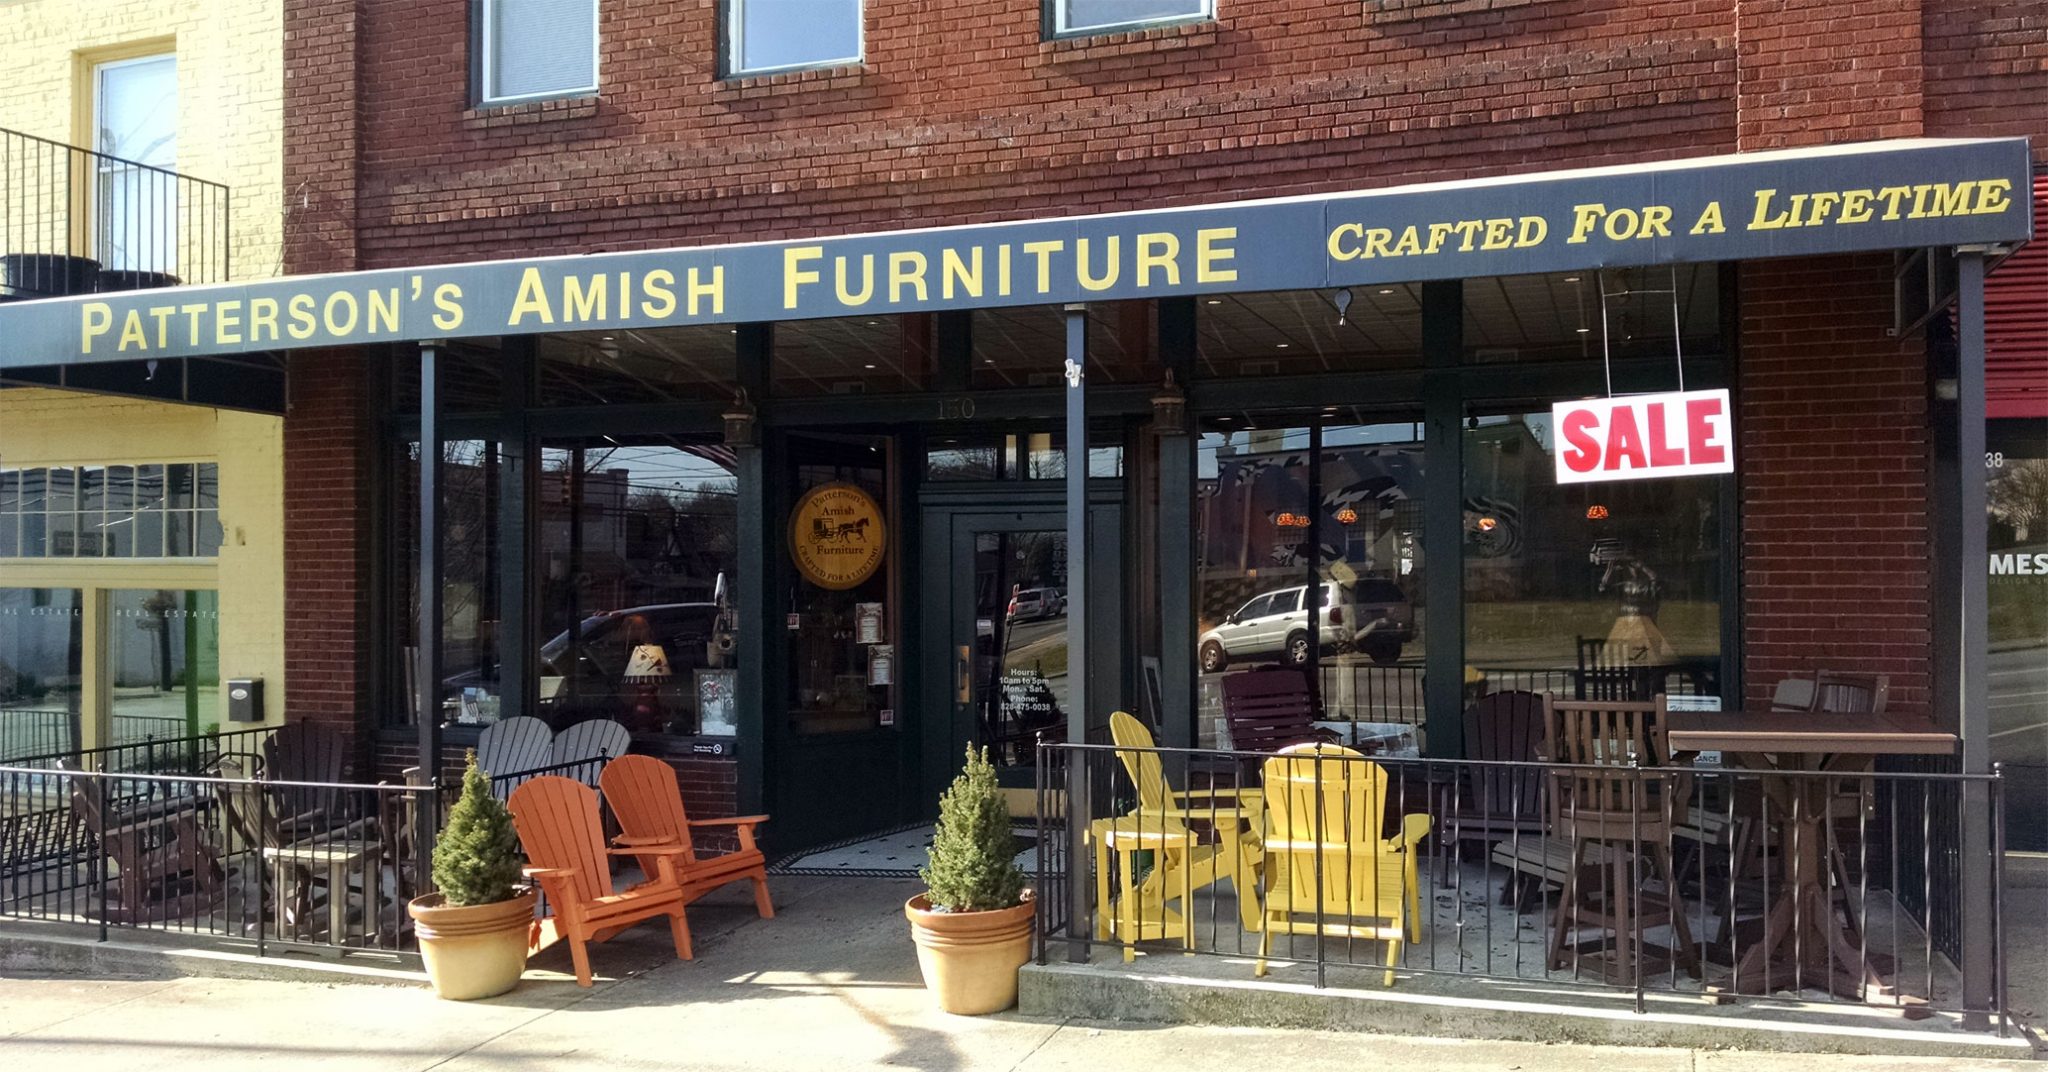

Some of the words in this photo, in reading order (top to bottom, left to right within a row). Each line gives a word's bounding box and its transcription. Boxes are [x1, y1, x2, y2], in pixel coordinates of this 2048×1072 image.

[1328, 216, 1548, 261] CRAFTED
[1567, 203, 1673, 244] FOR
[1690, 202, 1726, 235] A
[1747, 178, 2012, 231] LIFETIME
[82, 276, 464, 354] PATTERSON'S
[509, 267, 724, 326] AMISH
[784, 227, 1238, 309] FURNITURE
[1562, 398, 1725, 473] SALE
[811, 490, 866, 508] Patterson's
[821, 506, 855, 516] Amish
[816, 545, 865, 555] Furniture
[1989, 553, 2048, 575] MES
[827, 573, 843, 581] FOR
[31, 607, 79, 617] ESTATE
[116, 609, 149, 618] REAL
[164, 609, 217, 620] ESTATE
[1010, 668, 1038, 676] Hours:
[999, 676, 1021, 685] 10am
[1022, 676, 1031, 685] to
[1031, 676, 1050, 686] 5pm
[1002, 685, 1022, 693] Mon.
[1029, 685, 1046, 693] Sat.
[1010, 694, 1038, 702] Phone:
